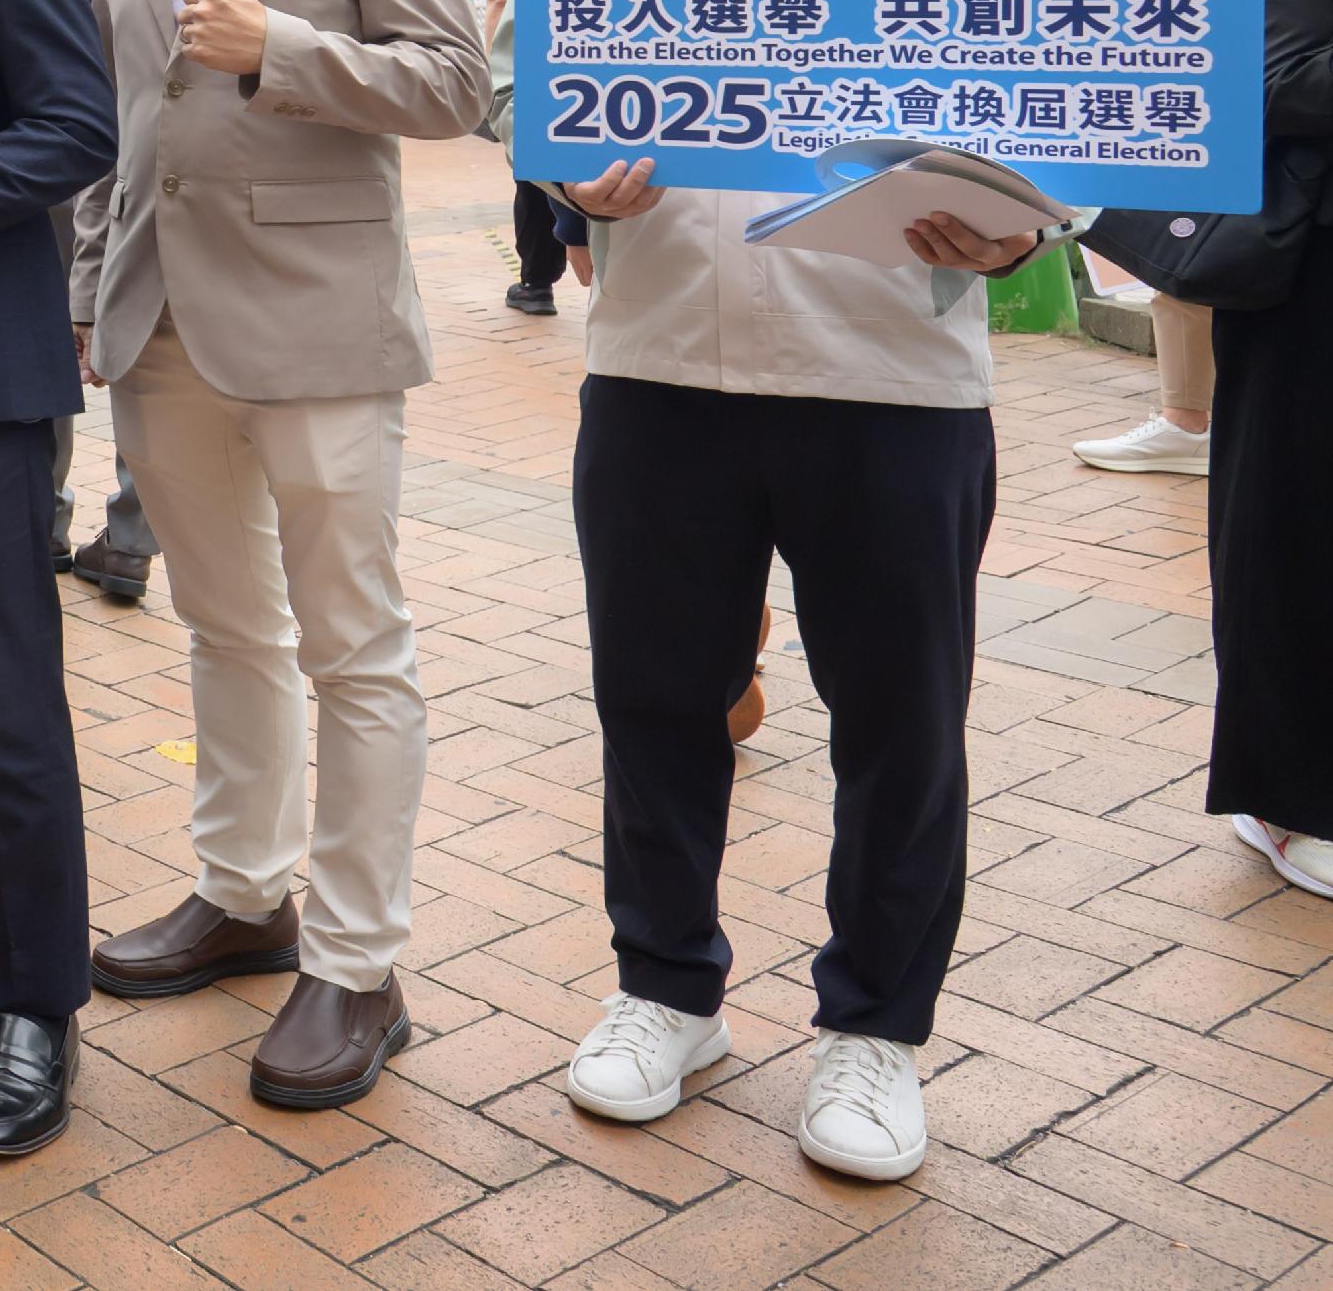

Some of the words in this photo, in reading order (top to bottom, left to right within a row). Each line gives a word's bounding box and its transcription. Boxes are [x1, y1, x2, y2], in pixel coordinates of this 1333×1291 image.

[552, 41, 602, 59] Join
[607, 42, 648, 59] the
[654, 41, 756, 62] Election
[761, 42, 884, 66] Together
[890, 44, 933, 64] We
[940, 44, 1034, 66] Create
[1043, 45, 1093, 66] the
[1101, 46, 1205, 68] Future
[553, 78, 767, 144] 2025
[778, 82, 1202, 133] 立法會換屆選舉
[779, 131, 870, 152] Legisl
[995, 139, 1091, 158] General
[1098, 141, 1201, 161] Election
